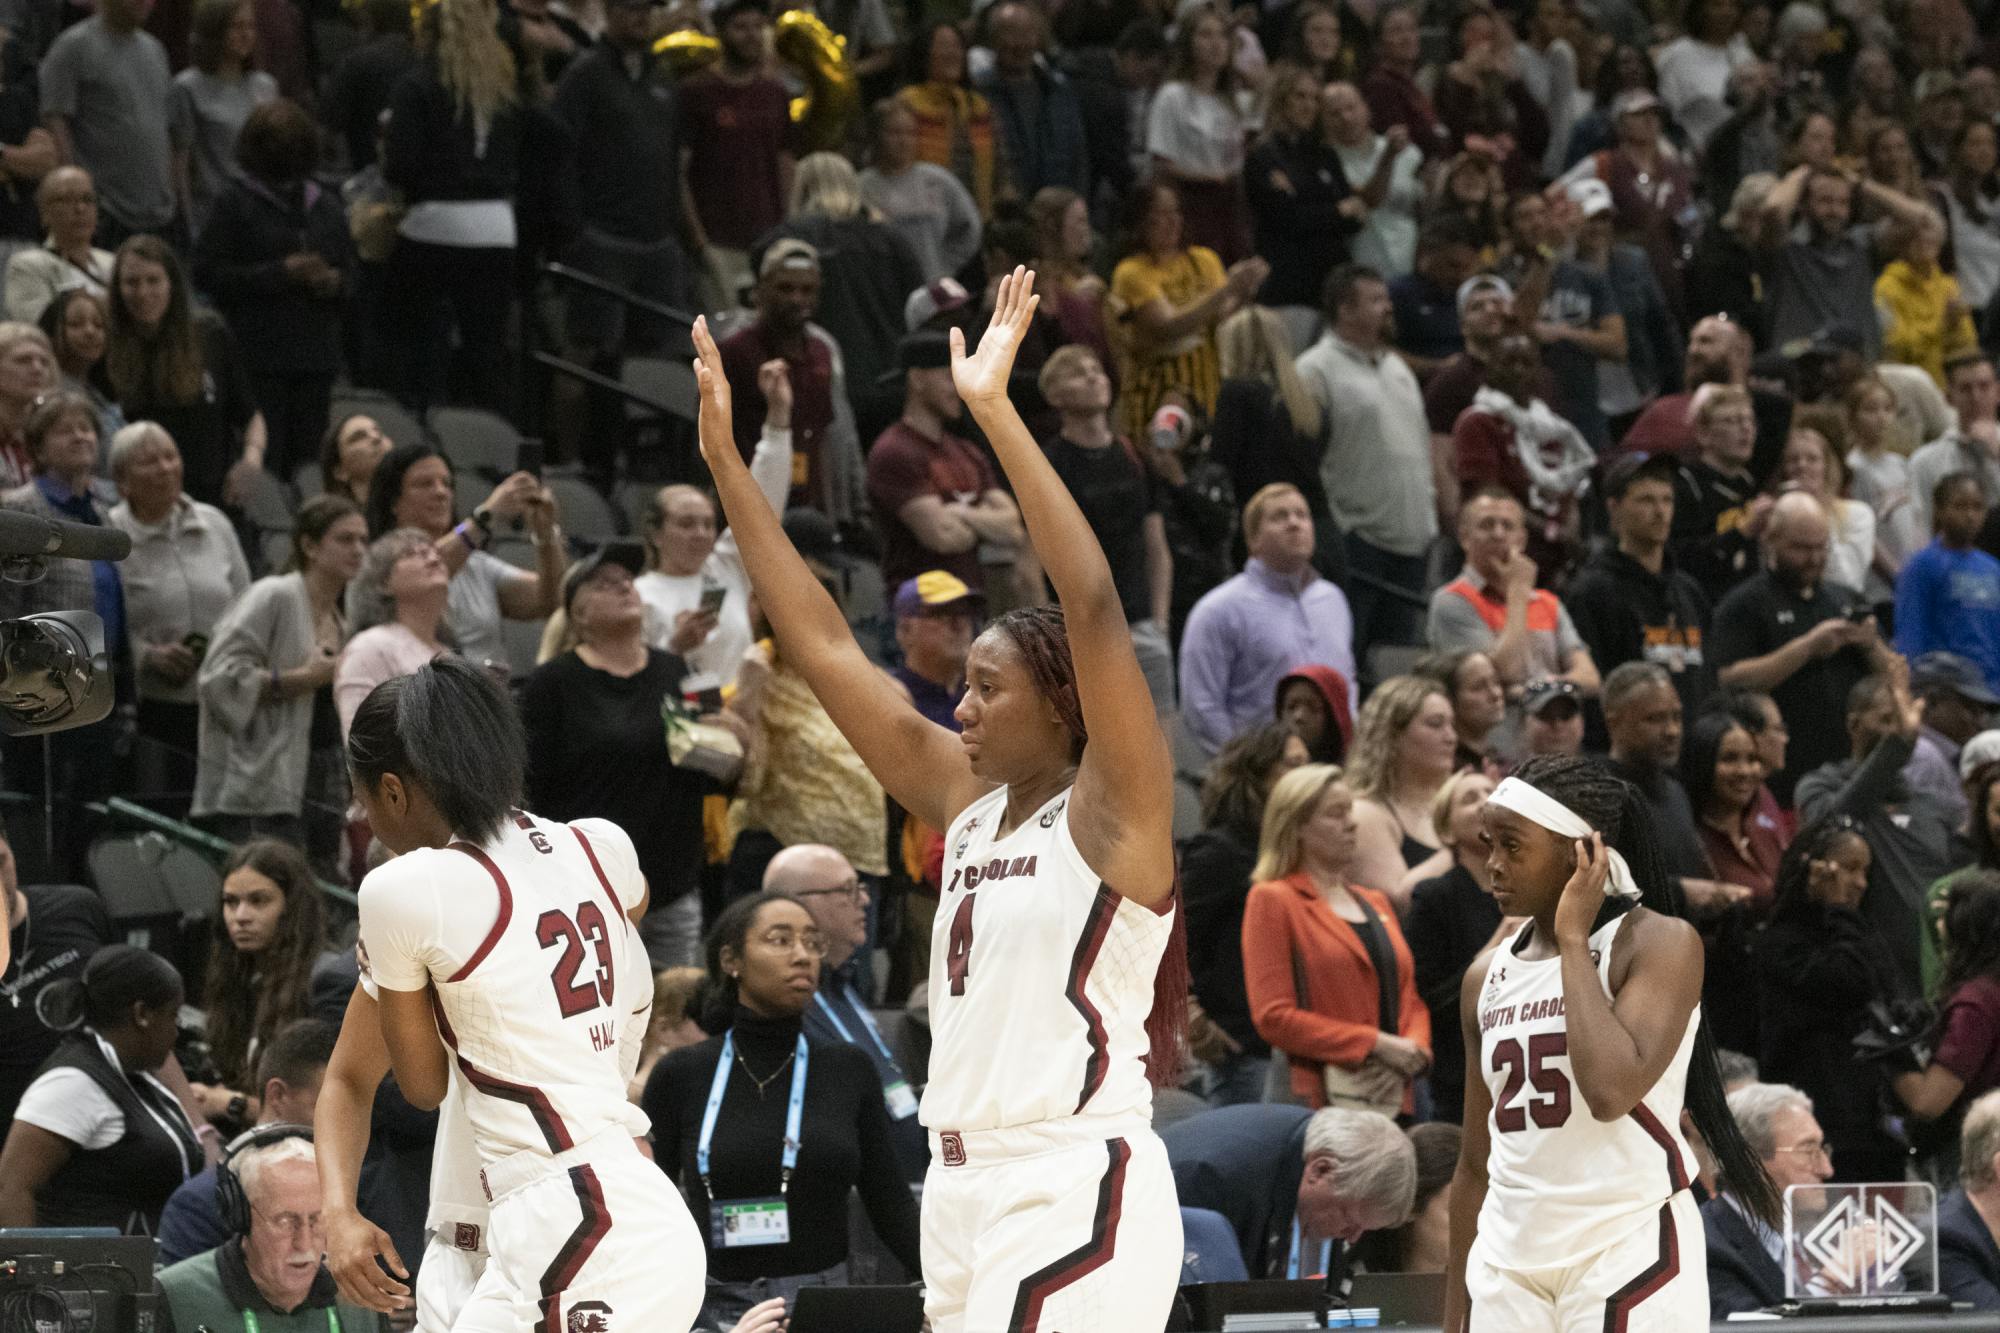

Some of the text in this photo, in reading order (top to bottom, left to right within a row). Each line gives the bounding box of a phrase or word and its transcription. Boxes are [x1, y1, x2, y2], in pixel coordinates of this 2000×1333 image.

[46, 947, 80, 971] TECH
[535, 900, 615, 1019] 23
[946, 892, 977, 997] 4
[1520, 996, 1566, 1022] CAROL
[1491, 1031, 1572, 1134] 25
